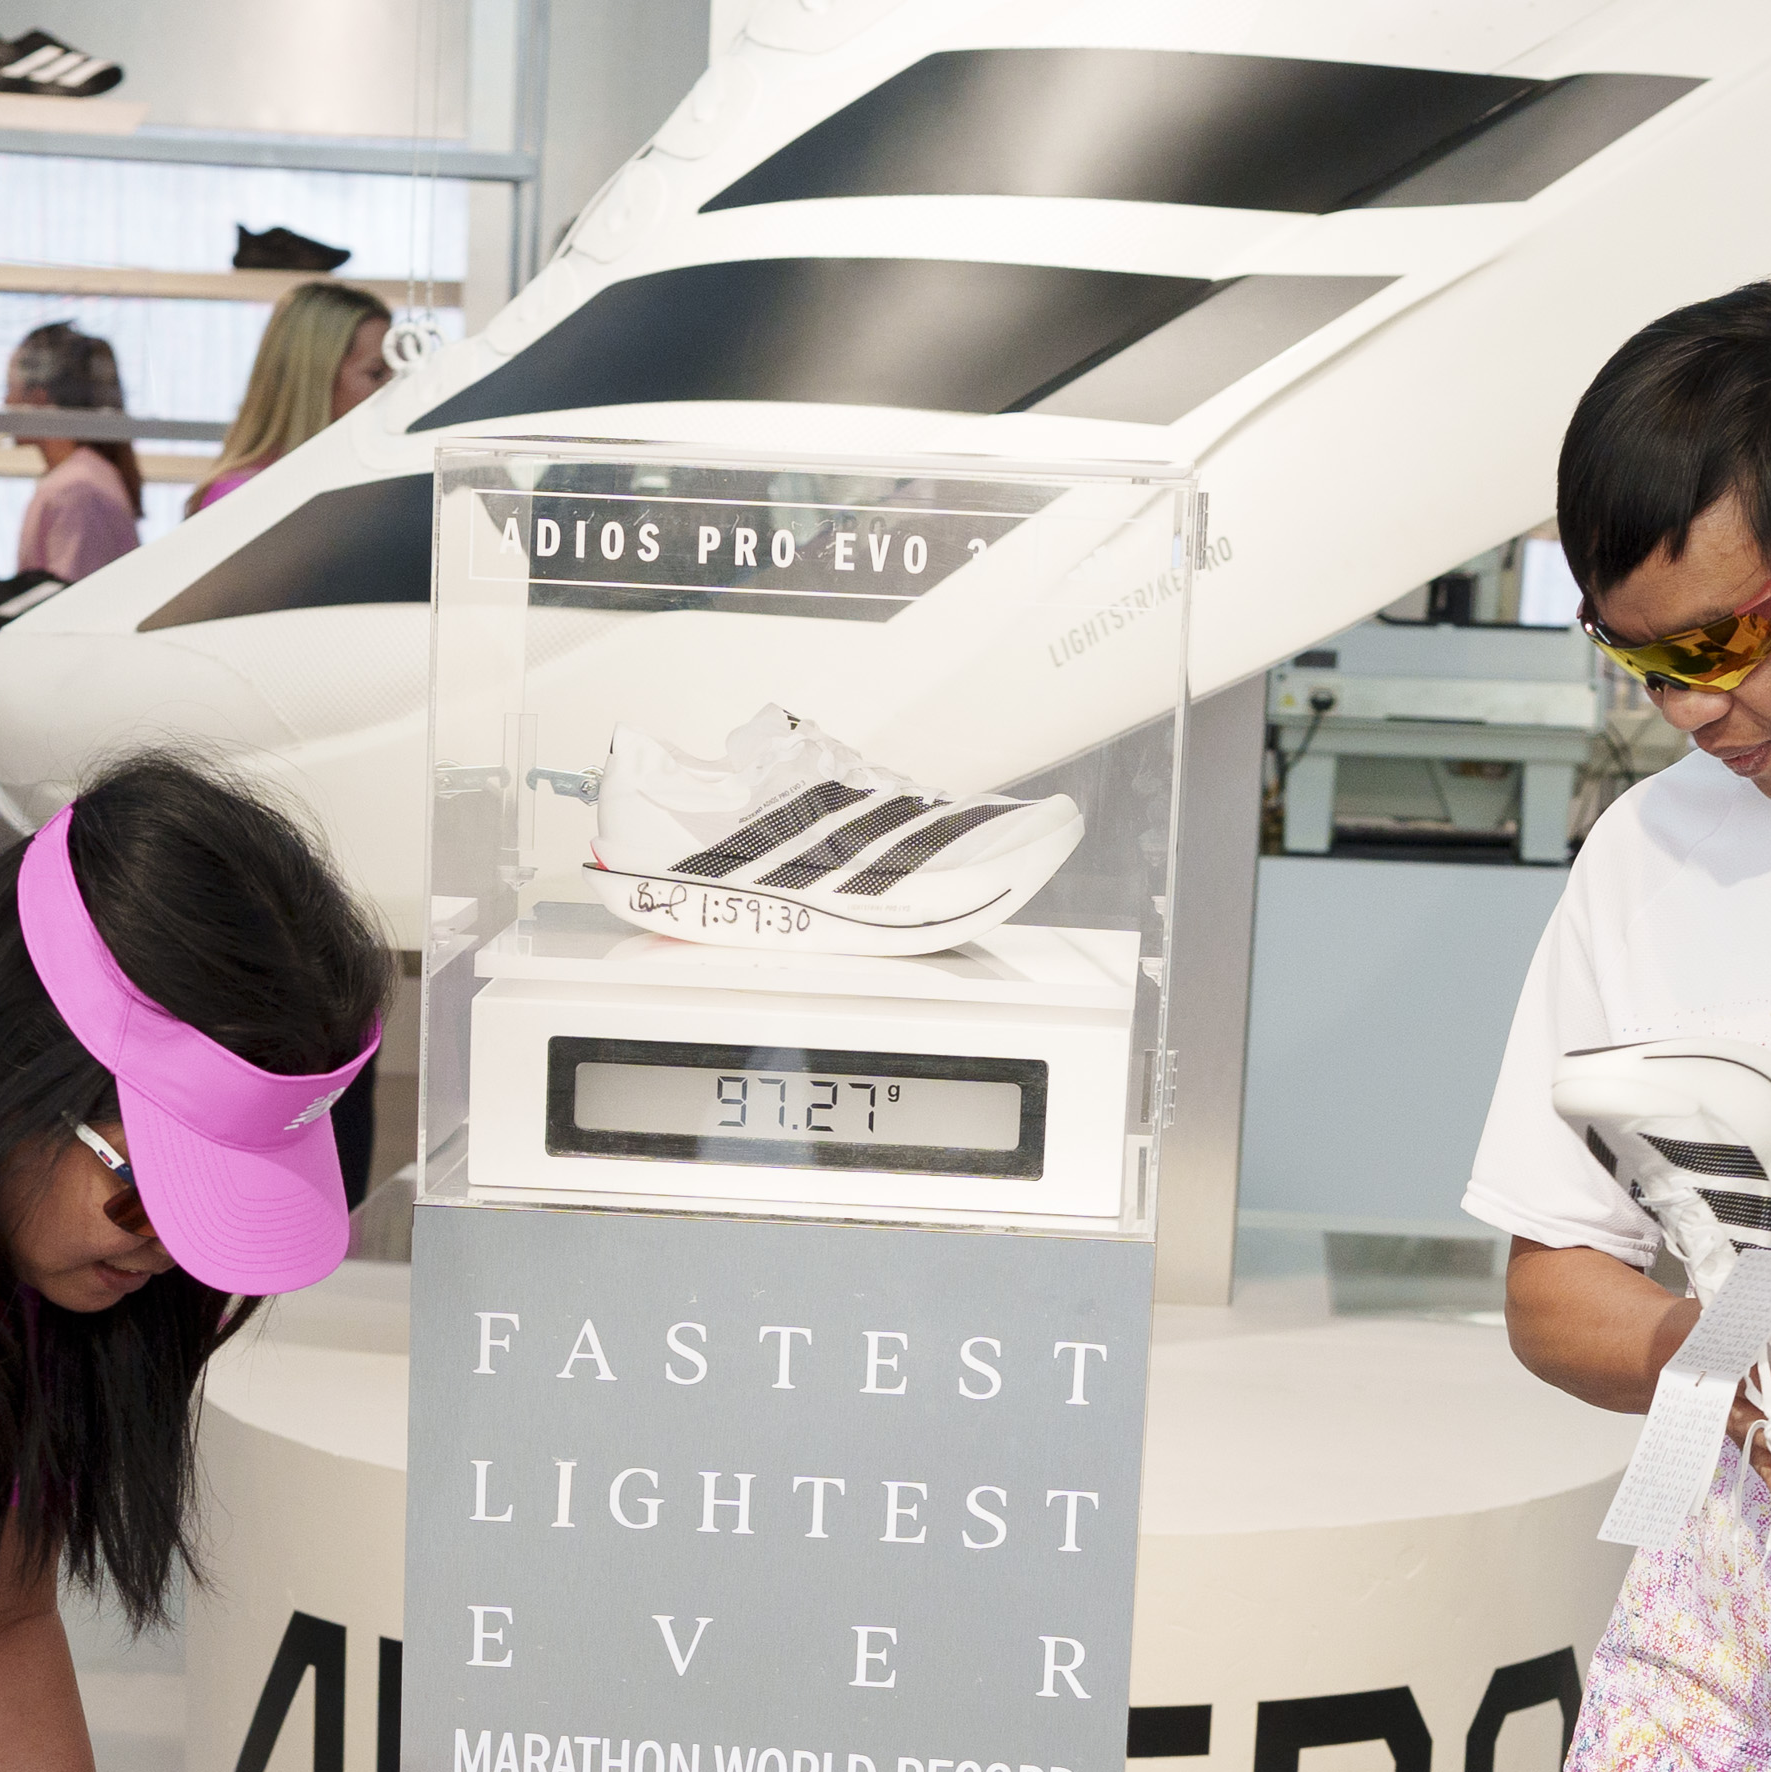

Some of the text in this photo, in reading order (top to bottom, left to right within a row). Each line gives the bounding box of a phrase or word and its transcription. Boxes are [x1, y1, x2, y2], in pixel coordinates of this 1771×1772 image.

[499, 517, 661, 562] ADIOS
[698, 526, 796, 569] PRO
[834, 532, 928, 575] EVO
[701, 893, 811, 934] 1:59:30
[472, 1311, 1108, 1406] FASTEST
[469, 1459, 1100, 1552] LIGHTEST
[465, 1604, 1092, 1699] EVER
